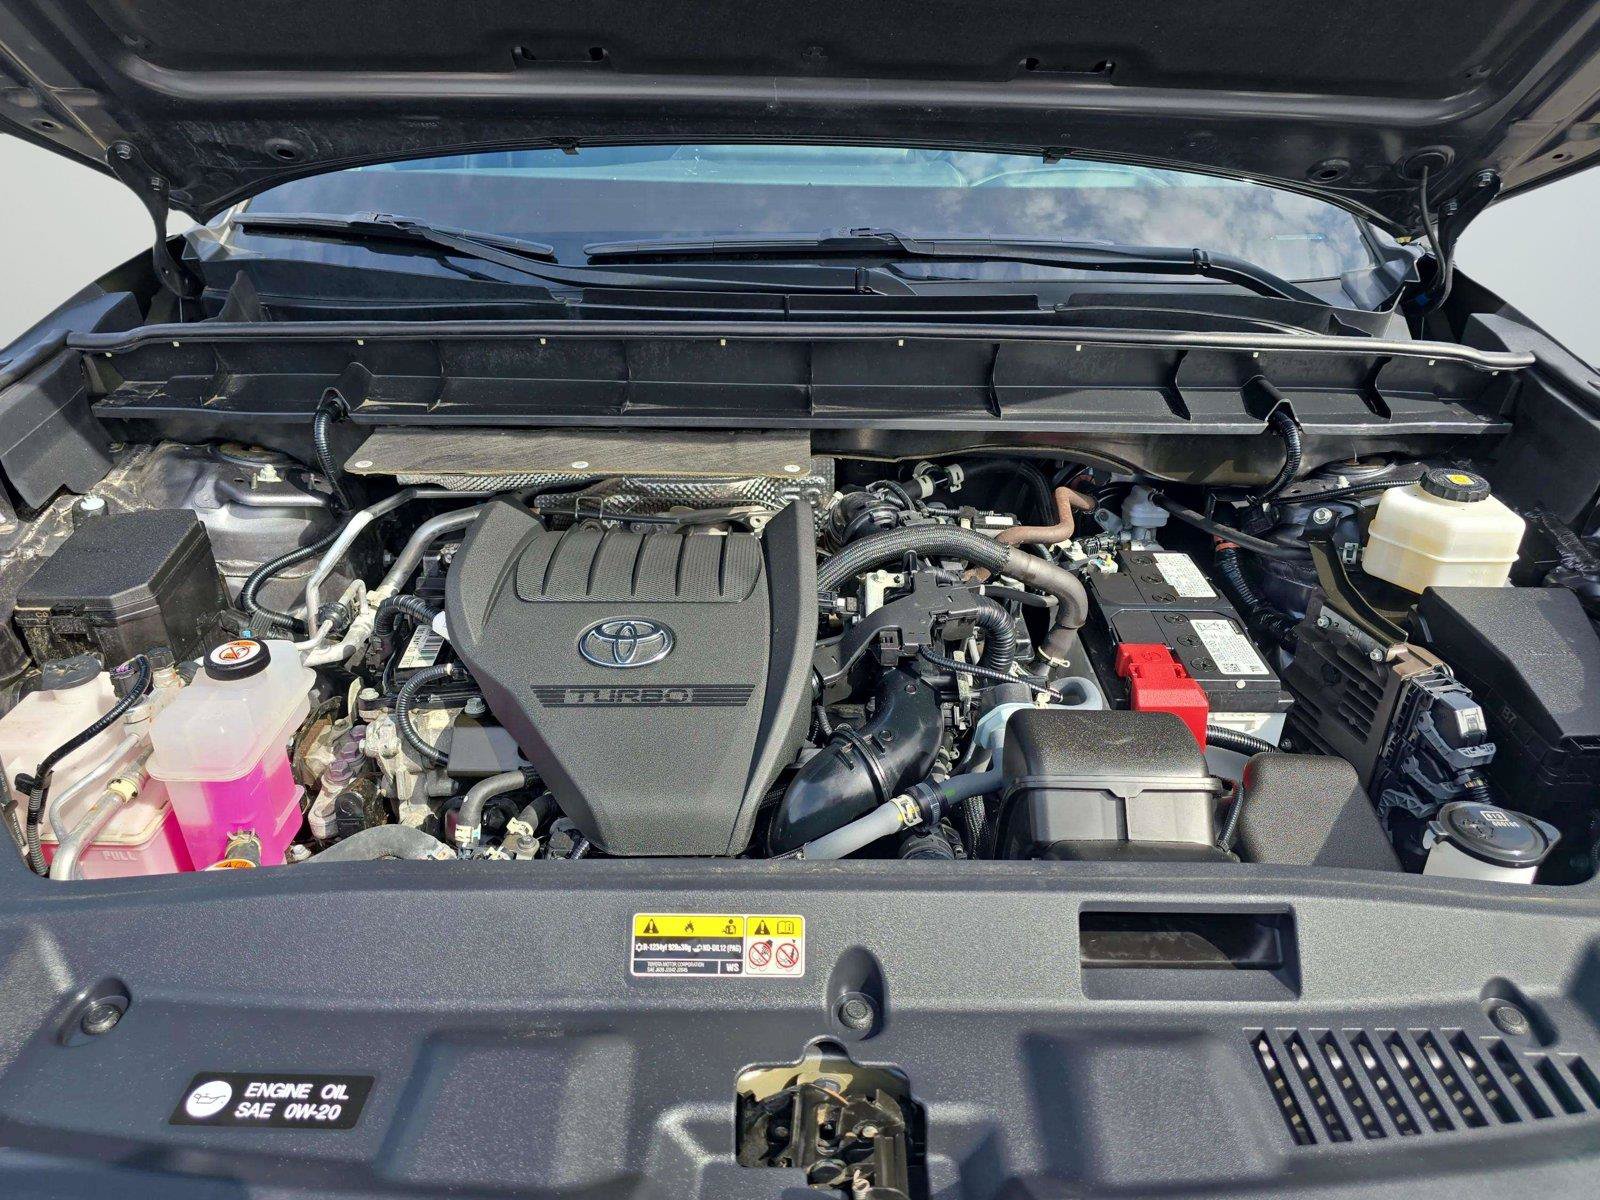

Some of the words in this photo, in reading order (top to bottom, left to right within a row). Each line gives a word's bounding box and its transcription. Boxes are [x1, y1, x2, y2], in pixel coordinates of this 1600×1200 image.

[565, 688, 693, 703] TURBO
[244, 1082, 313, 1099] ENGINE
[320, 1083, 349, 1101] OIL
[234, 1102, 275, 1118] SAE
[284, 1103, 342, 1120] 0W-20
